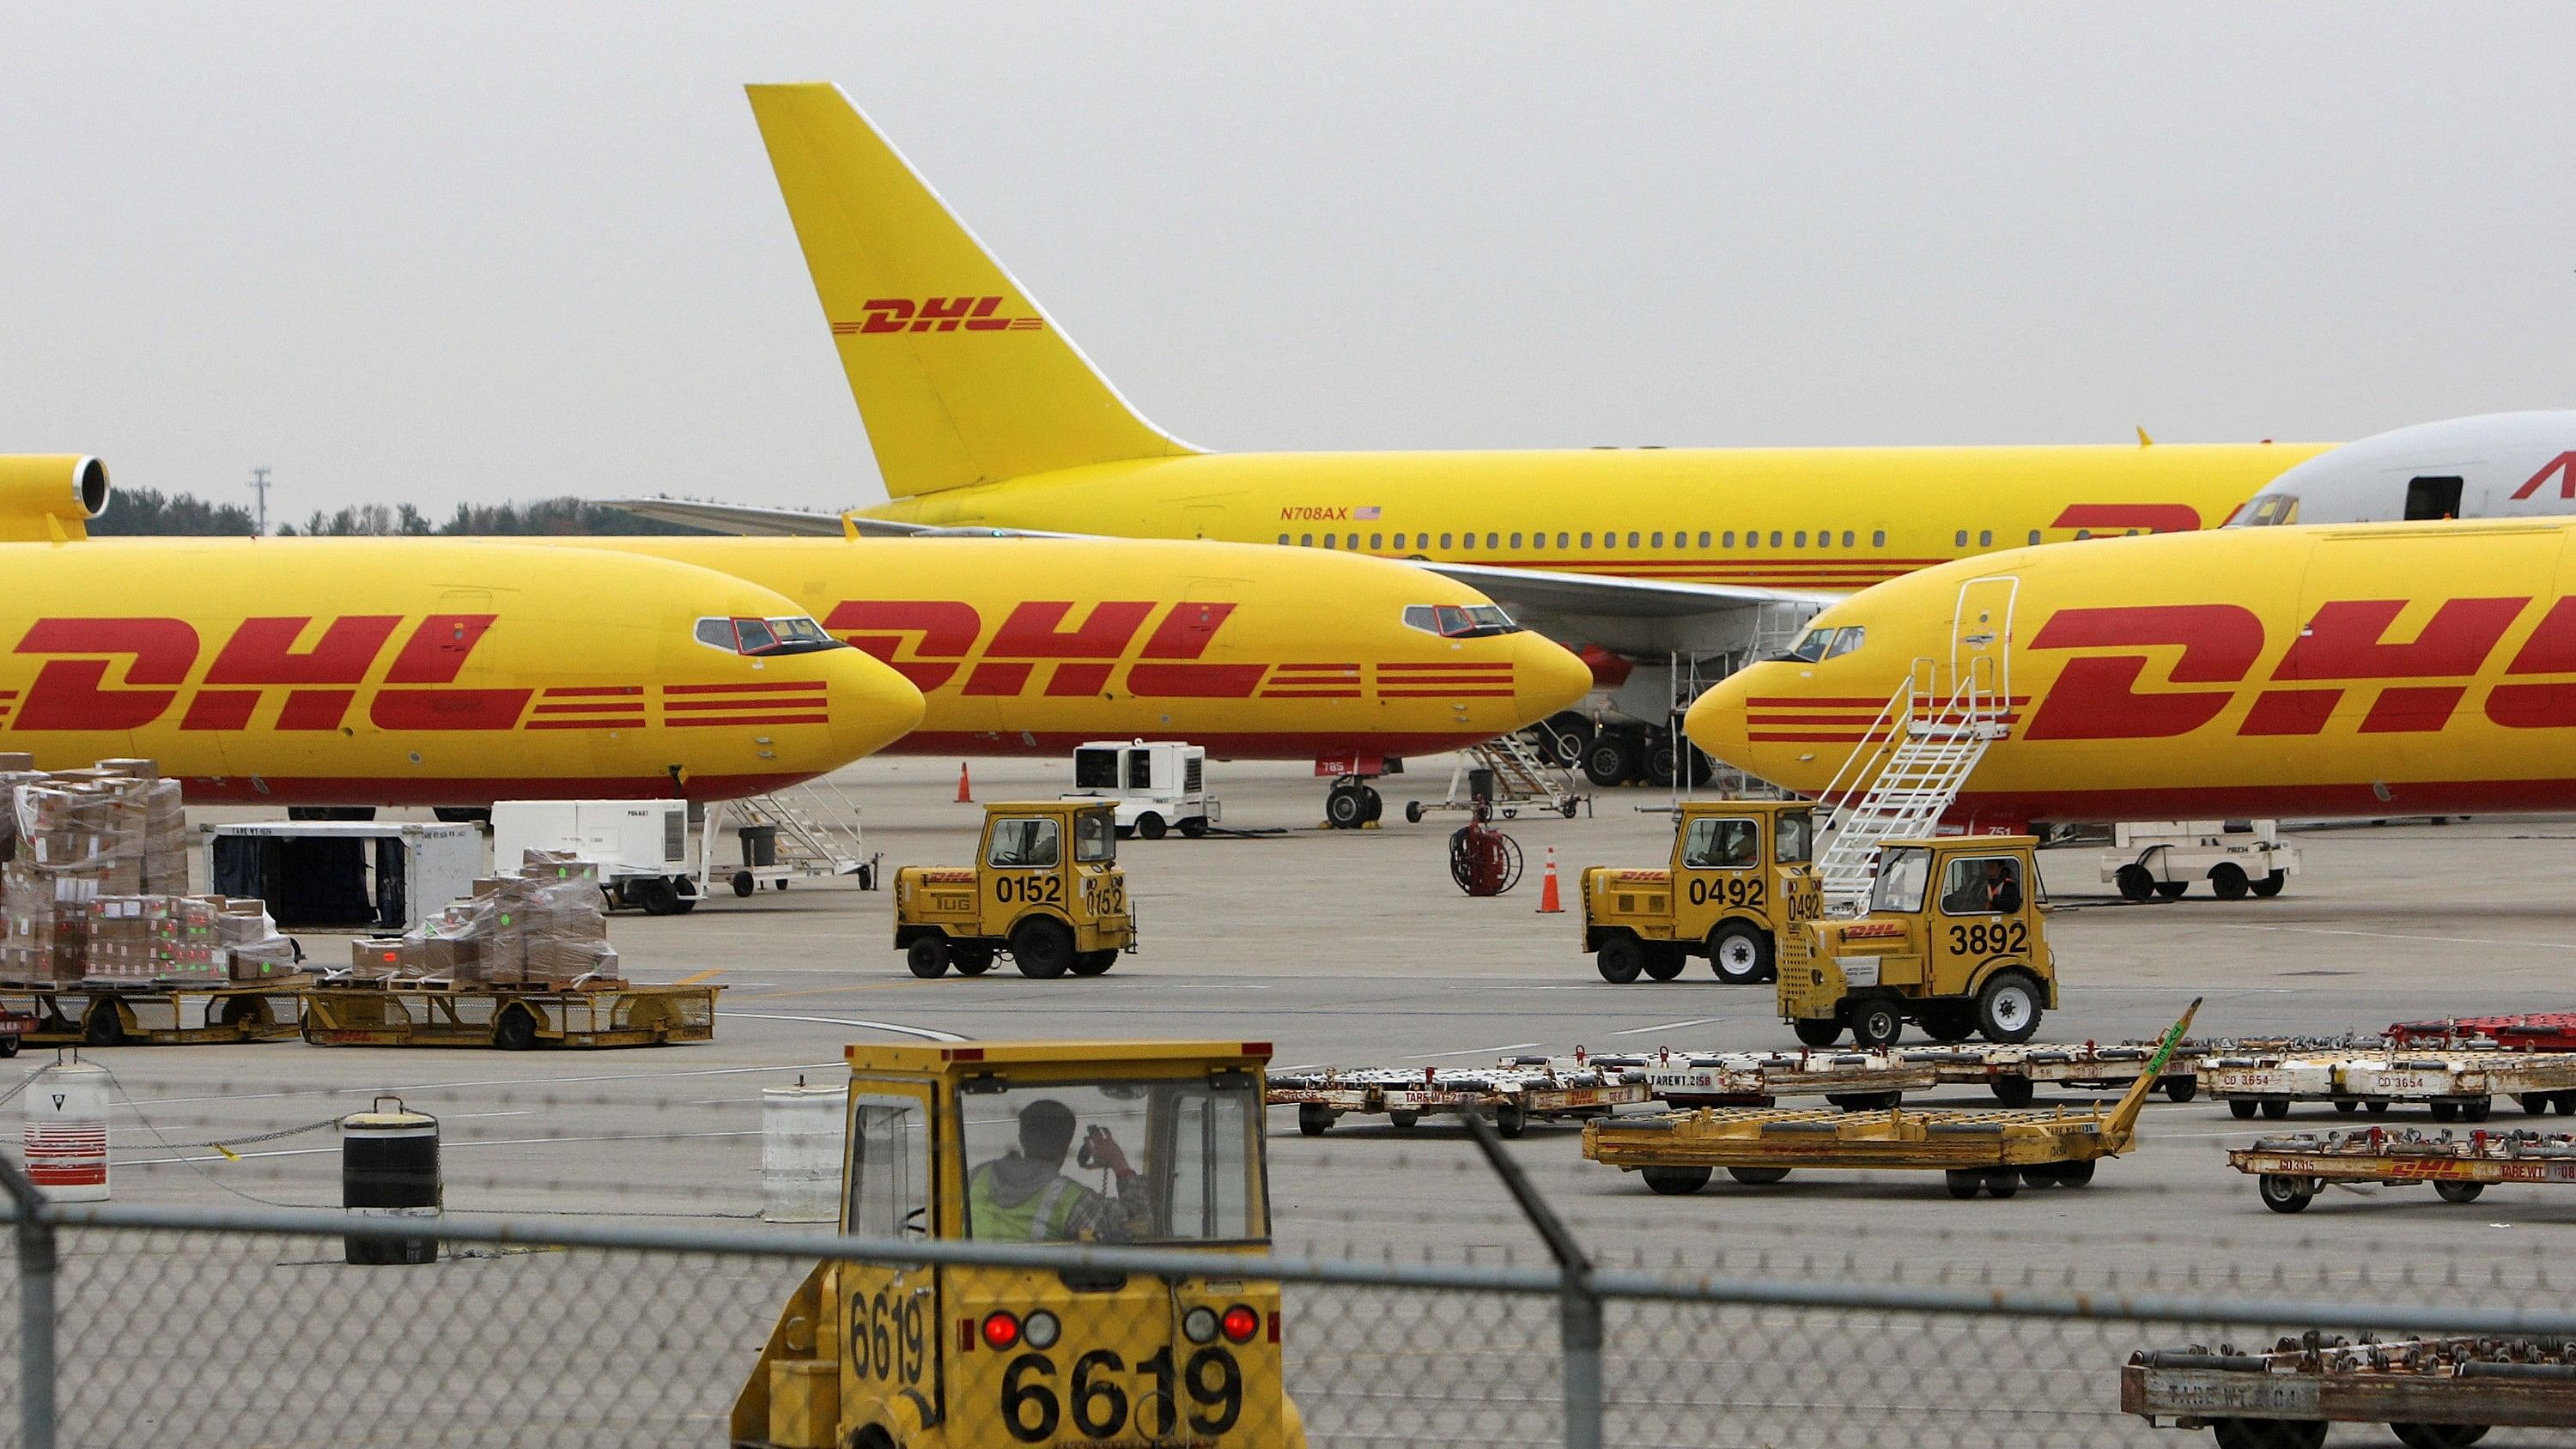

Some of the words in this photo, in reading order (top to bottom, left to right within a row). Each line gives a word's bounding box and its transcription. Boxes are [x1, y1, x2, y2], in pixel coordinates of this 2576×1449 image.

[860, 296, 1012, 333] DHL
[1280, 506, 1347, 520] N708AX
[821, 601, 1263, 698] DHL
[11, 614, 534, 731] DHL
[996, 876, 1061, 903] 0152
[1619, 870, 1668, 881] DHL
[1086, 889, 1122, 917] 0152
[1689, 877, 1764, 906] 0492
[1788, 893, 1820, 921] 0492
[1846, 923, 1905, 937] DHL
[1949, 923, 2028, 955] 3892
[2157, 1027, 2182, 1060] TYPE
[2149, 1064, 2158, 1073] 3
[2224, 1076, 2237, 1085] CD
[2242, 1075, 2269, 1085] 3654
[2378, 1077, 2391, 1087] CD
[2396, 1077, 2423, 1088] 3654
[2390, 1155, 2461, 1178] DHL
[2500, 1166, 2524, 1178] TARE
[851, 1290, 922, 1385] 6619
[1000, 1346, 1242, 1444] 6619
